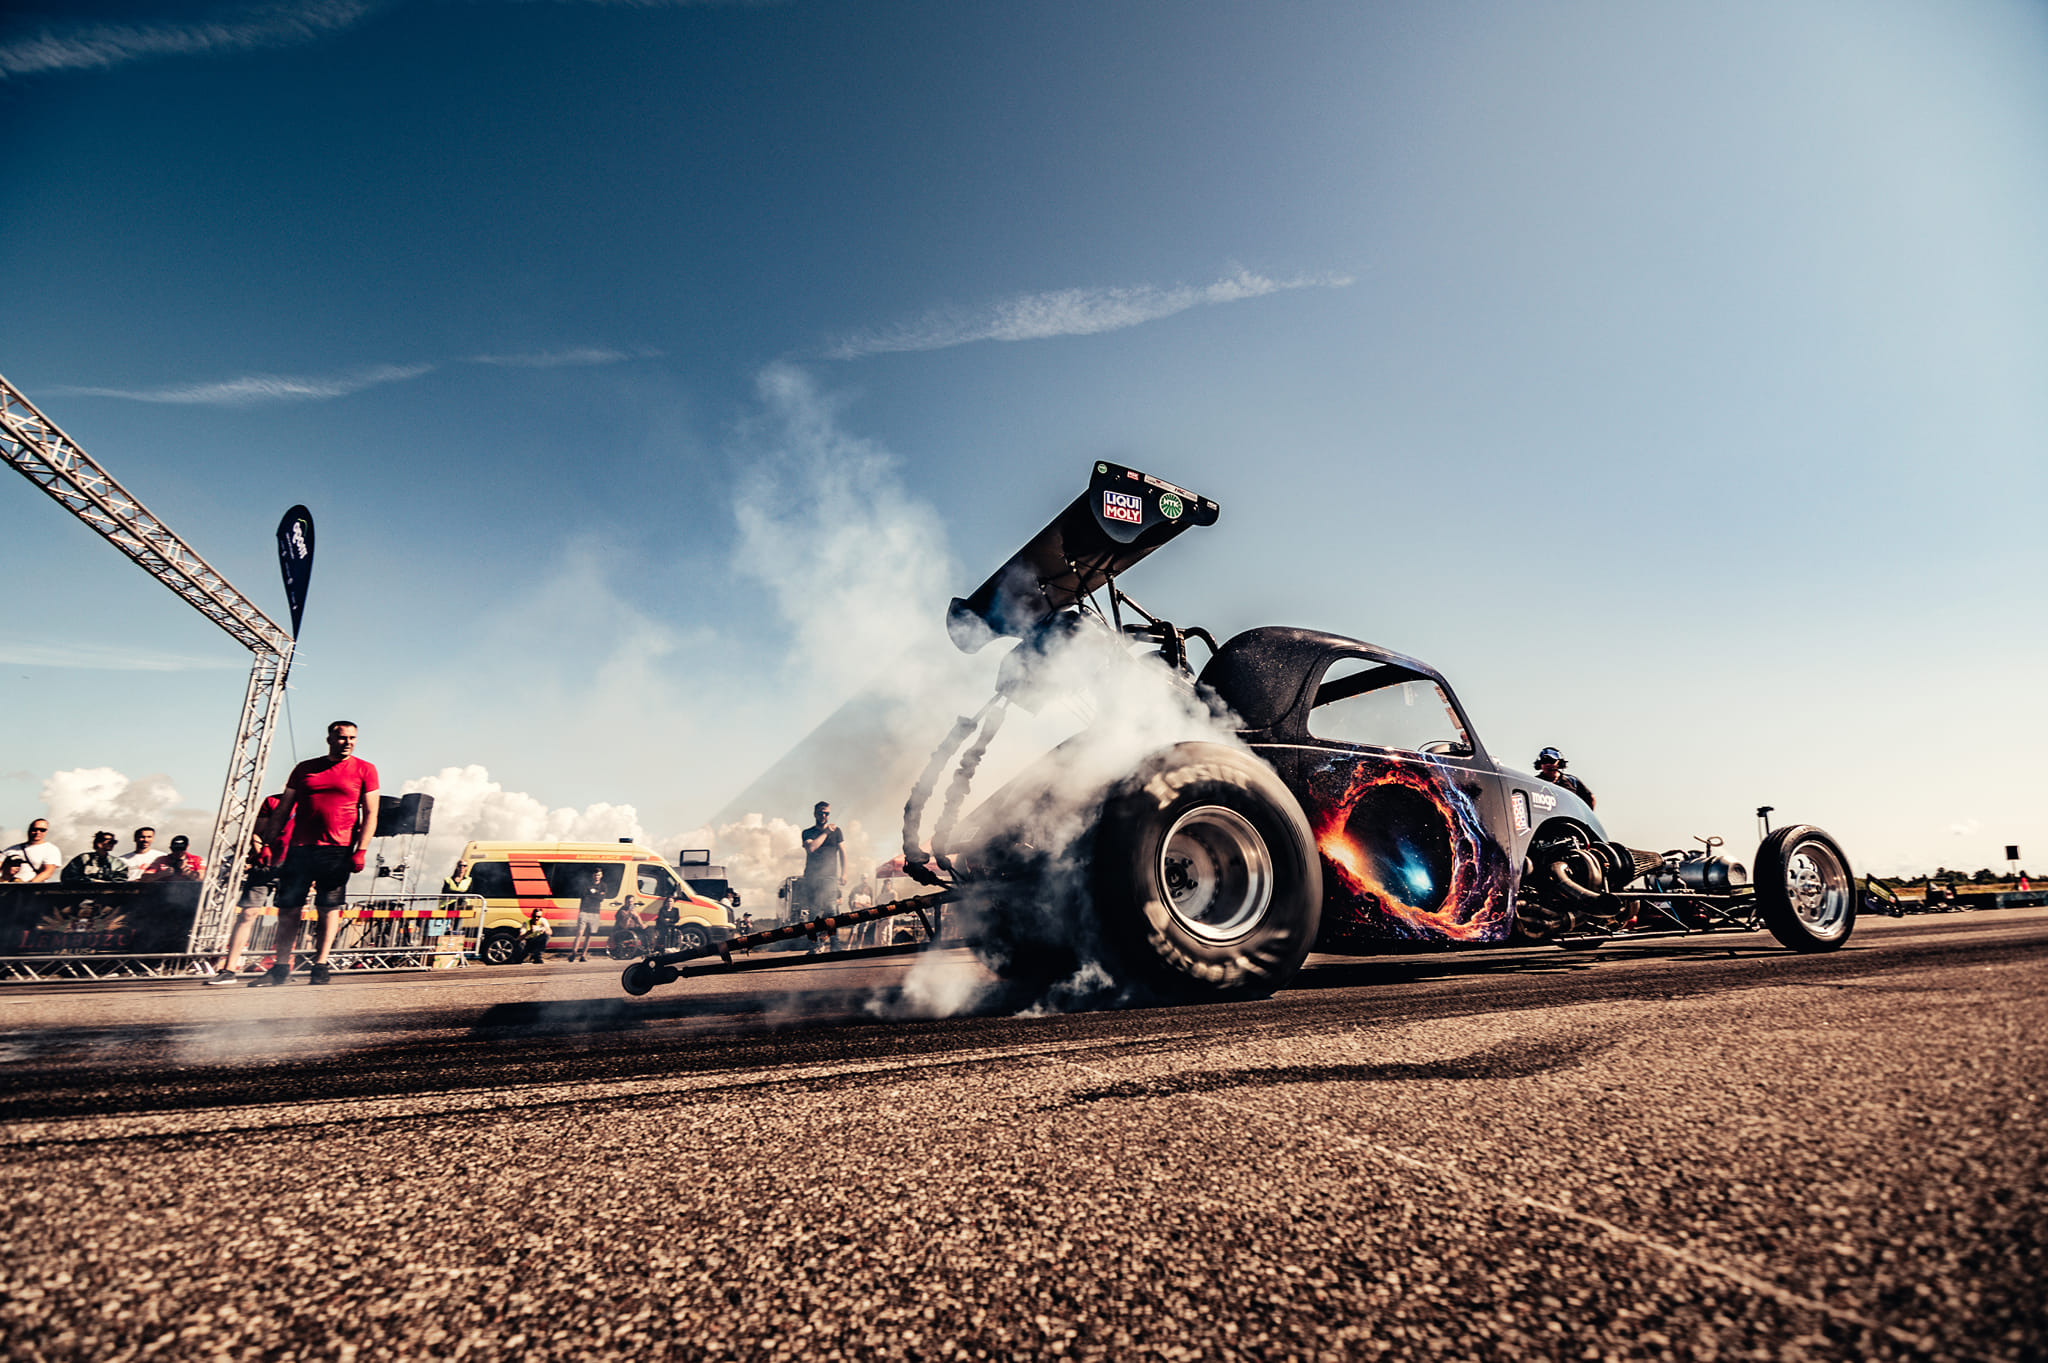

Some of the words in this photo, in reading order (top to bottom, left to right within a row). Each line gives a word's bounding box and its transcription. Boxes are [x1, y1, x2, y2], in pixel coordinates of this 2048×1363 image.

[1107, 493, 1139, 510] LIQUI
[1106, 505, 1140, 522] MOLY
[1531, 791, 1556, 811] mogo
